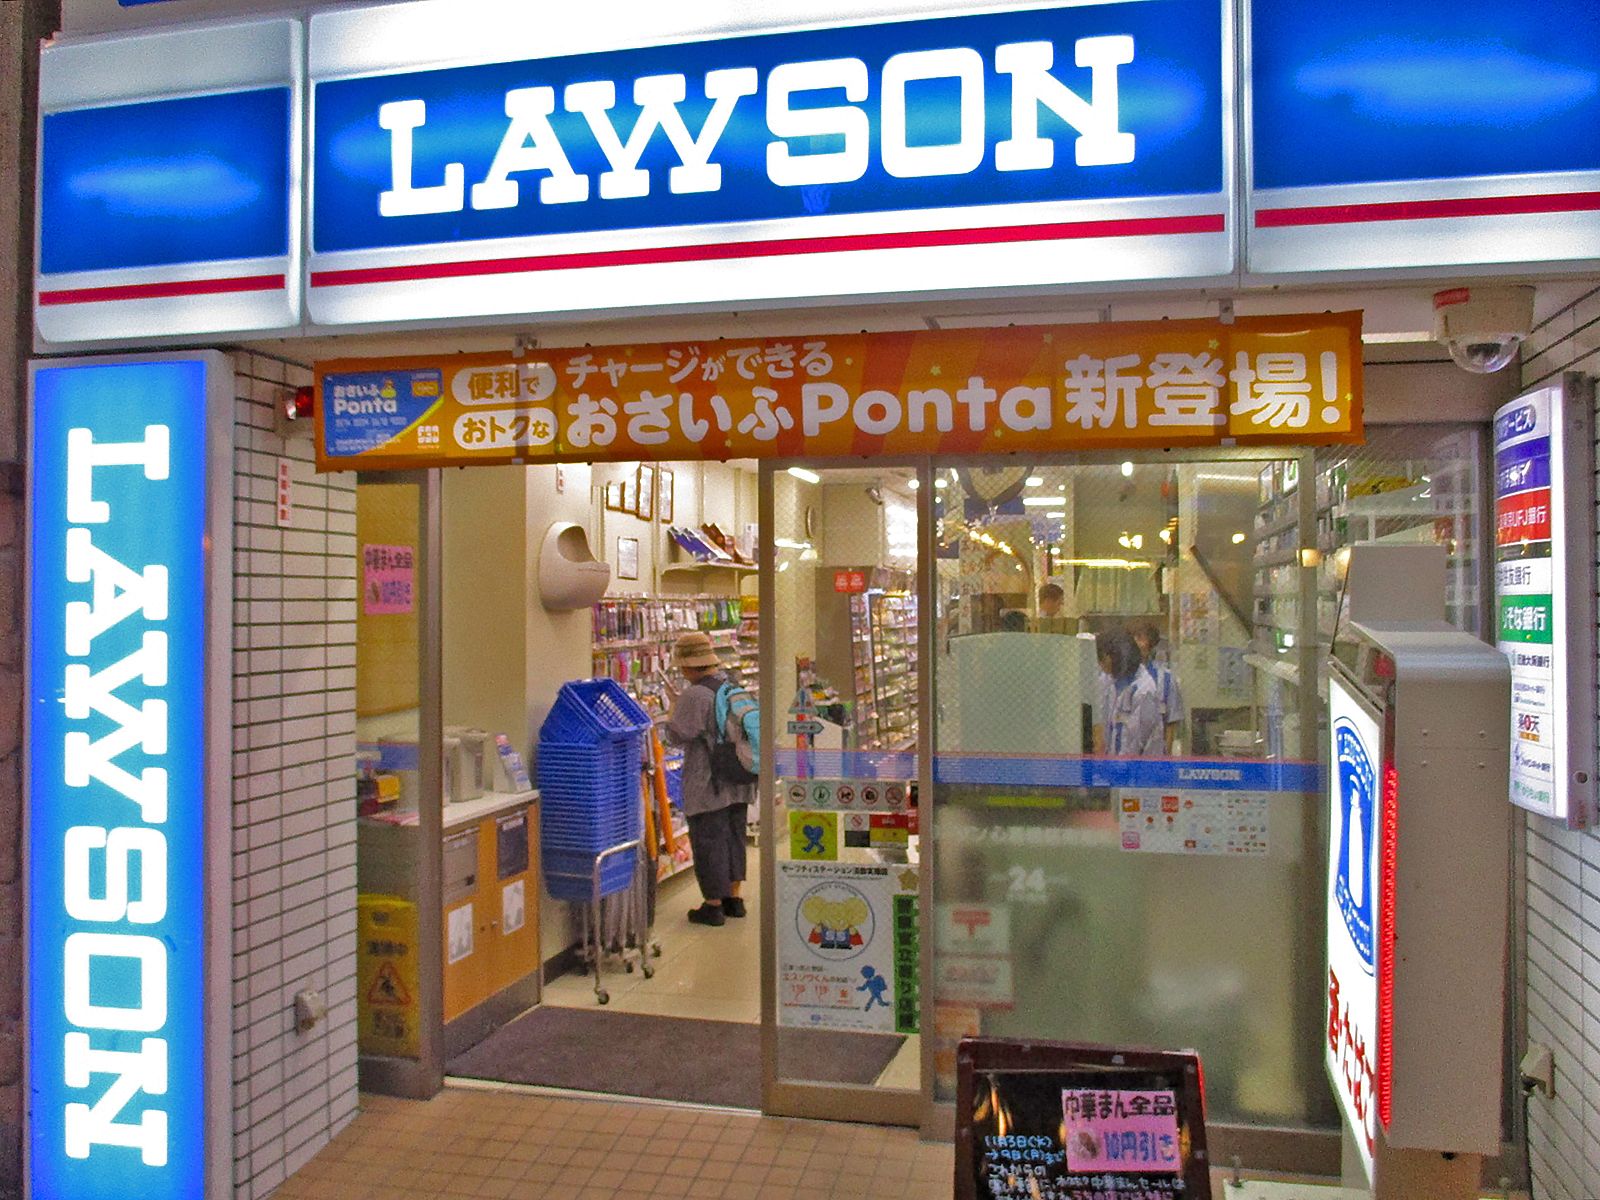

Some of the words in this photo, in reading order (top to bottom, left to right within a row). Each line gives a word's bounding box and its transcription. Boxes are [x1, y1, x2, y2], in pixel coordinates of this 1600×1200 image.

[379, 34, 1136, 218] LAWSON
[566, 341, 834, 389] チャージができる
[468, 370, 540, 400] 便利で
[333, 399, 398, 416] Ponta
[462, 415, 550, 444] おトクな
[1178, 767, 1243, 781] LAWSON
[64, 423, 170, 1168] LAWSON
[1065, 1090, 1175, 1121] 中華まん全品
